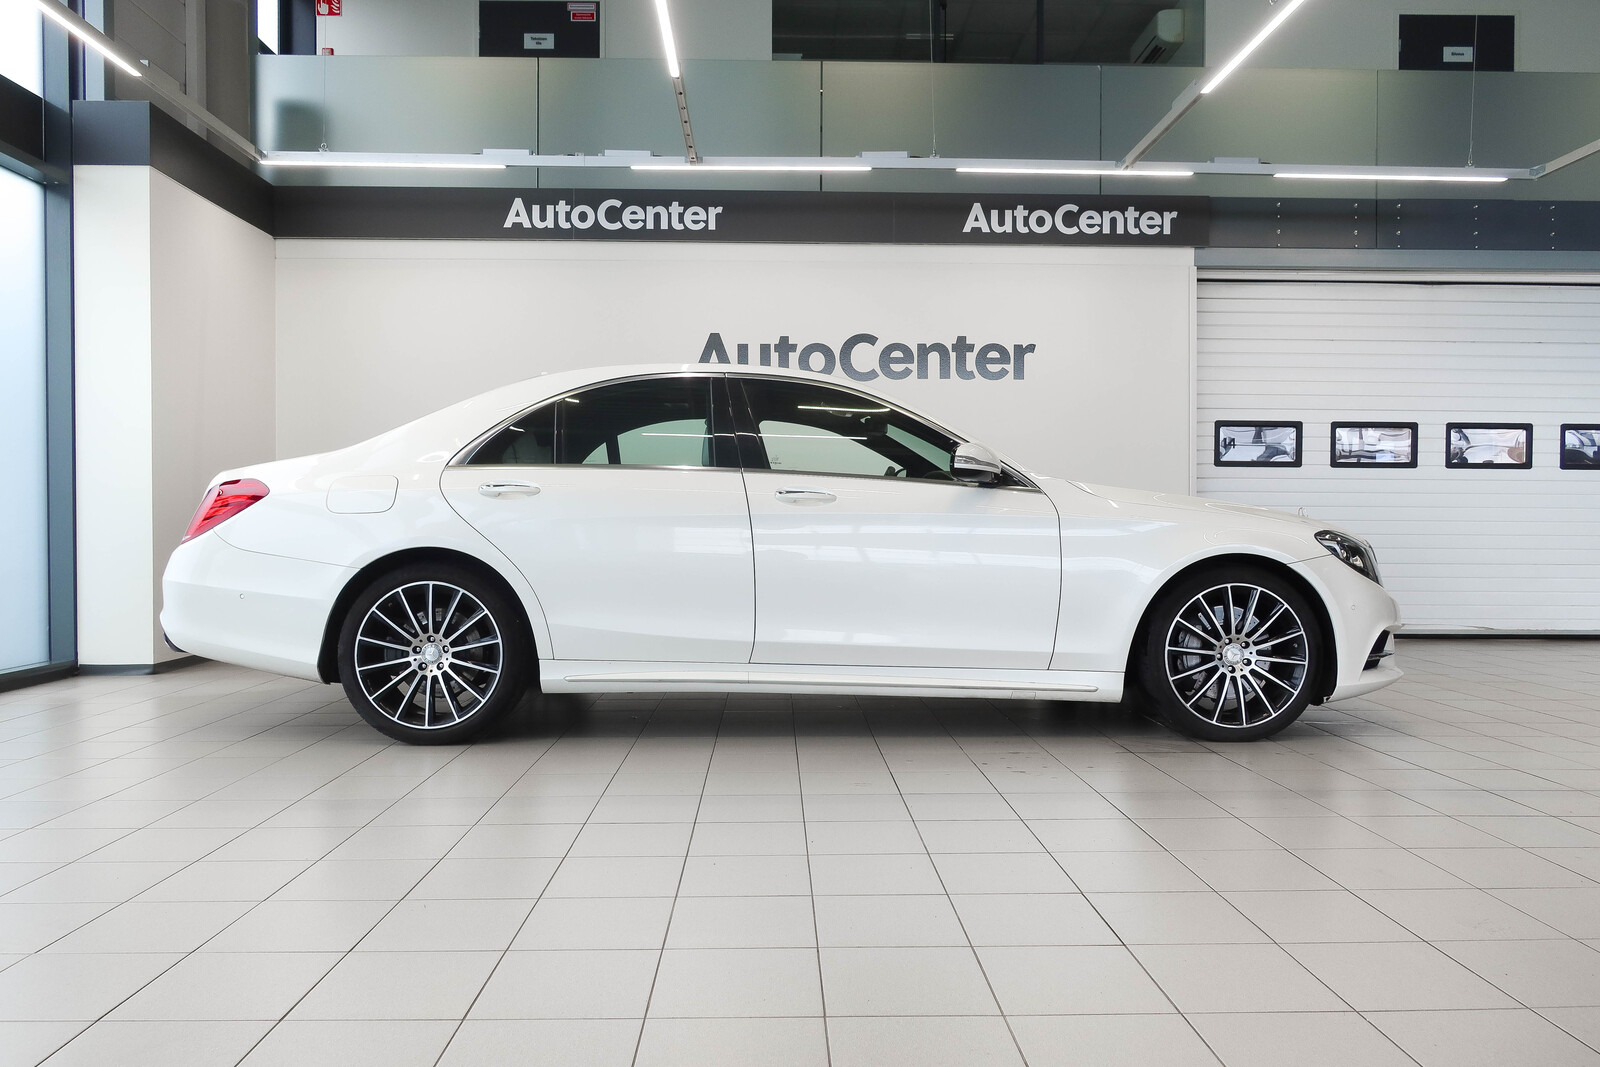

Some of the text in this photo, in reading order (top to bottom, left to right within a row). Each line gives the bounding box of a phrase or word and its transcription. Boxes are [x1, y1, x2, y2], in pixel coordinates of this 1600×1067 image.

[503, 197, 723, 230] AutoCenter
[962, 202, 1178, 235] AutoCenter
[698, 332, 1036, 382] AutoCenter
